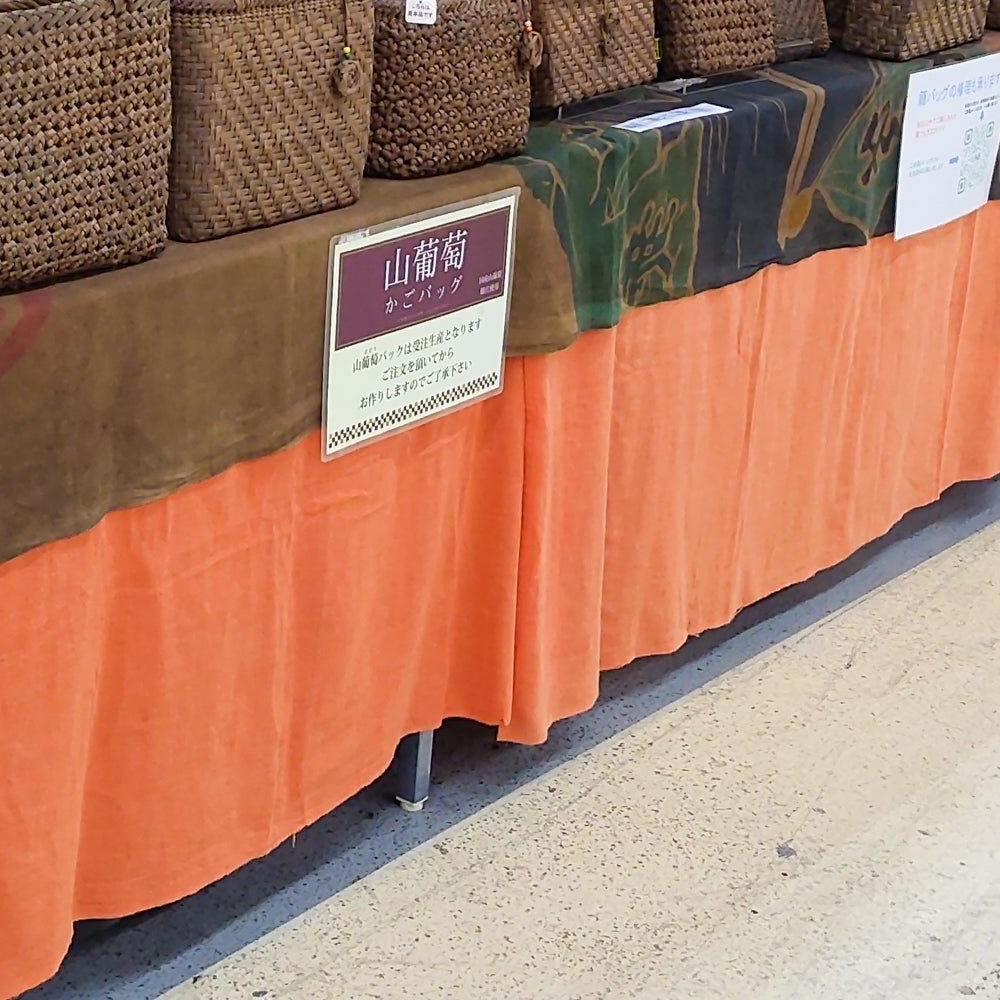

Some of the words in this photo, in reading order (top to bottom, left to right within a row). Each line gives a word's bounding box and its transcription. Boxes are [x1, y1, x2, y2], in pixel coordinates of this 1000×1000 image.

[384, 229, 468, 291] 山葡萄
[385, 275, 463, 314] かごバッグ
[359, 360, 473, 409] お作りしますのでご了承下さい
[381, 347, 454, 381] ご注文を頂いてから
